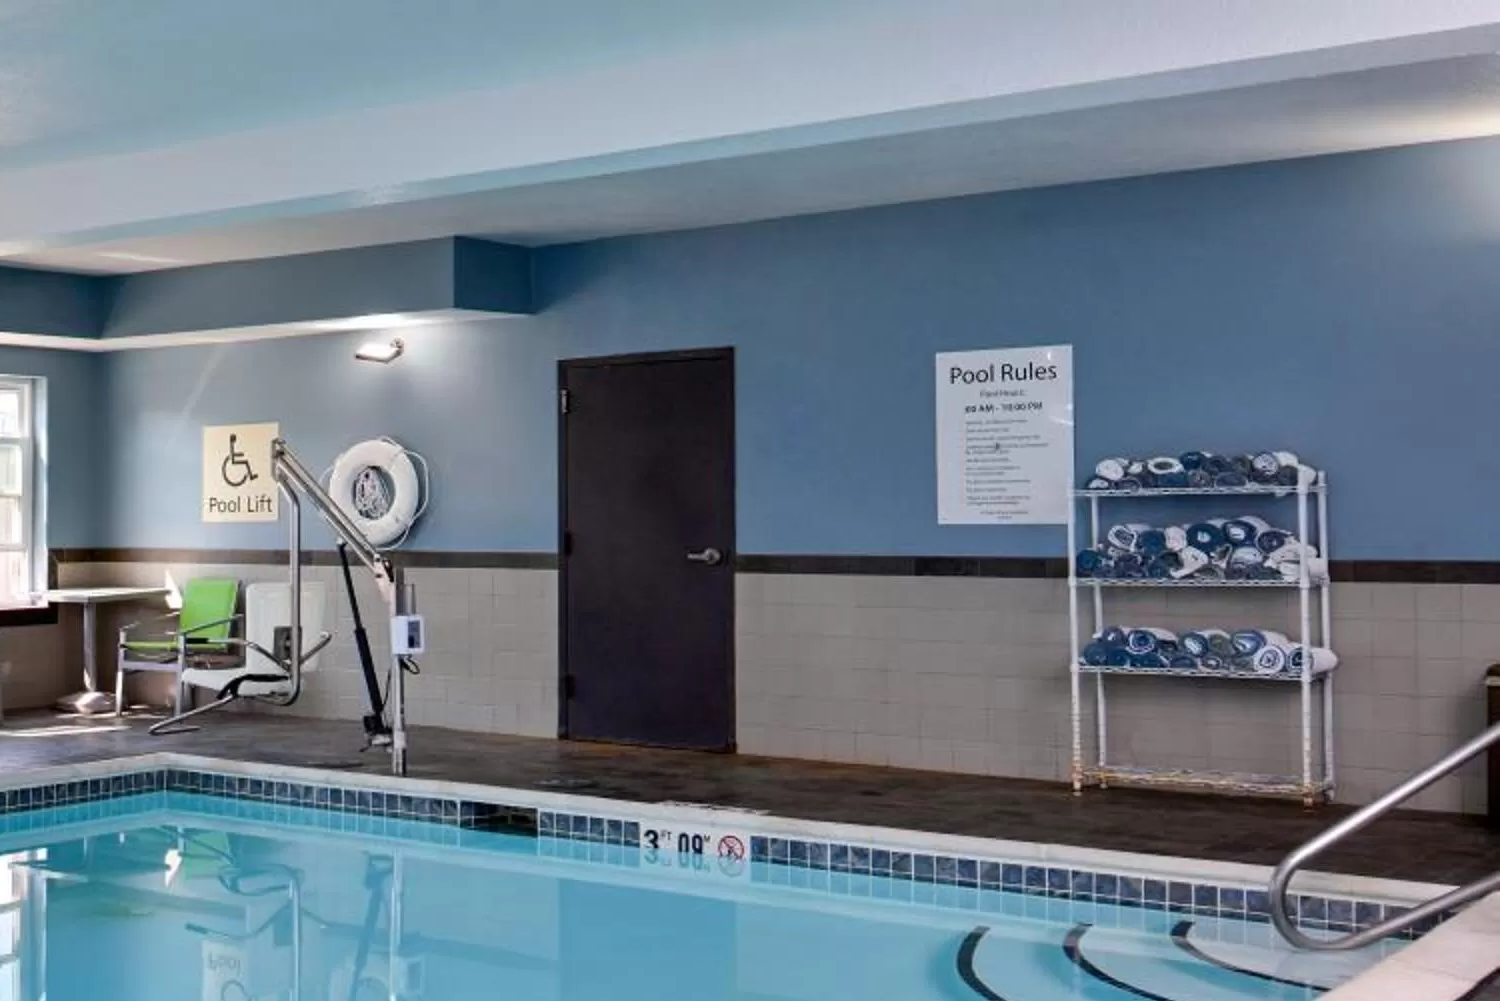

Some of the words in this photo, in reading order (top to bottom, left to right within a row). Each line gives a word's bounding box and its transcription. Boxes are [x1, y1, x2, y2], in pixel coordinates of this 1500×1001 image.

[950, 364, 994, 384] Pool
[1001, 362, 1057, 381] Rules
[209, 495, 241, 513] Pool
[247, 494, 273, 513] Lift
